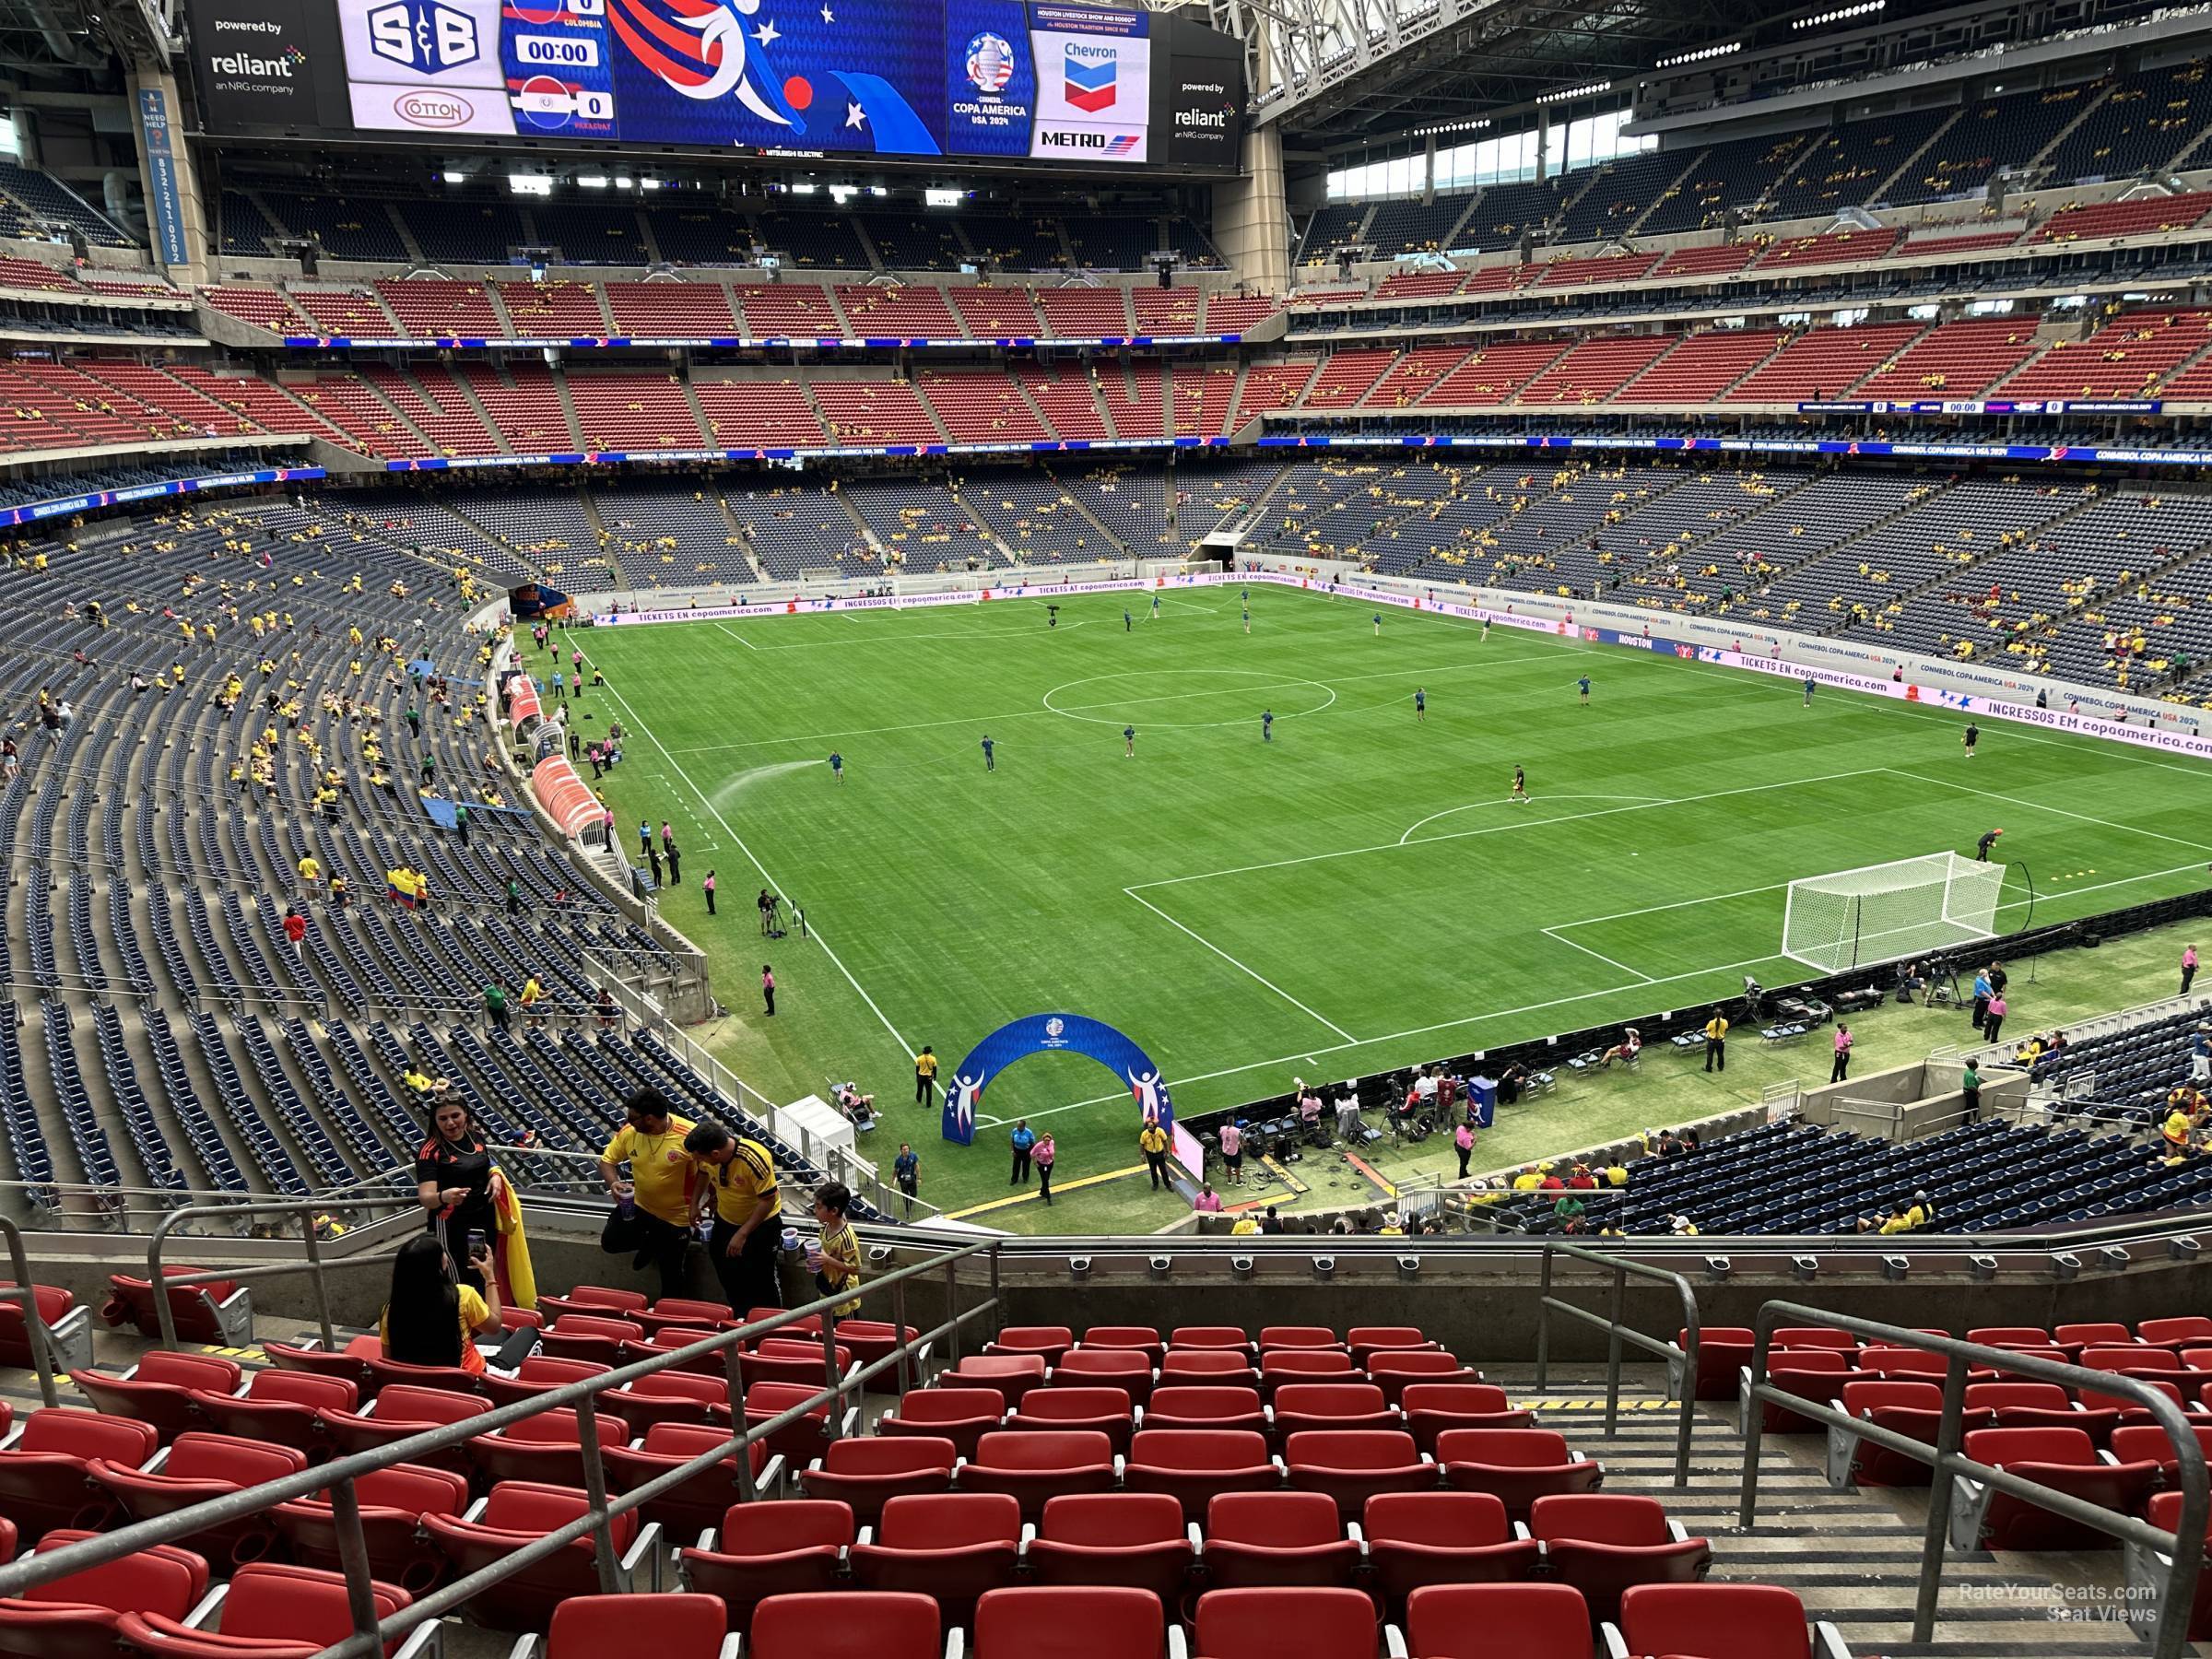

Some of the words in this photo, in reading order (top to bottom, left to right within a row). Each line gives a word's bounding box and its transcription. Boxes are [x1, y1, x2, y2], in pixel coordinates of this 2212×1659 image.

[215, 20, 266, 31] powered
[267, 21, 281, 35] by
[564, 18, 603, 29] COLOMBIA
[528, 41, 588, 63] 00:00
[1065, 42, 1117, 59] Chevron
[211, 53, 293, 76] reliant
[216, 82, 228, 90] an
[228, 81, 251, 91] NRG
[252, 84, 294, 96] company
[1182, 83, 1215, 92] powered
[1215, 84, 1225, 94] by
[405, 99, 462, 121] COTTON
[589, 98, 601, 114] 0
[953, 103, 981, 114] COPA
[982, 104, 1026, 116] AMERICA
[971, 116, 987, 124] USA
[990, 116, 1008, 125] 2024
[1175, 108, 1226, 127] reliant
[1041, 131, 1105, 148] METRO
[1182, 131, 1197, 139] NRG
[1197, 133, 1225, 142] company
[1877, 403, 1883, 411] 0
[1950, 403, 1976, 411] 00:00
[2052, 403, 2057, 411] 0
[2096, 452, 2139, 460] CONMEBOL
[2140, 453, 2162, 461] COPA
[2162, 453, 2200, 462] AMERICA
[1080, 582, 1145, 591] copaamerica.com
[903, 594, 973, 605] copaamerica.com
[639, 612, 674, 621] TICKETS
[692, 606, 772, 618] copaamerica.com
[1455, 606, 1478, 617] TICKETS
[1689, 624, 1717, 632] CONMEBOL
[1731, 629, 1753, 639] AMERICA
[1618, 634, 1653, 649] HOUSTON
[1799, 641, 1828, 652] CONMEBOL
[1829, 647, 1843, 655] COPA
[1844, 651, 1869, 660] AMERICA
[1882, 656, 1897, 665] 2024
[1741, 656, 1776, 671] TICKETS
[1779, 663, 1792, 675] EN
[1794, 667, 1888, 692] copaamerica.com
[1921, 665, 1955, 677] CONMEBOL
[1956, 671, 1972, 680] COPA
[1973, 676, 2003, 686] AMERICA
[2004, 680, 2017, 689] USA
[2018, 684, 2035, 692] 2024
[1988, 702, 2054, 724] INGRESSOS
[2059, 715, 2078, 728] EM
[2064, 693, 2104, 707] CONMEBOL
[2126, 706, 2160, 719] AMERICA
[2162, 712, 2178, 723] USA
[2179, 715, 2199, 726] 2024
